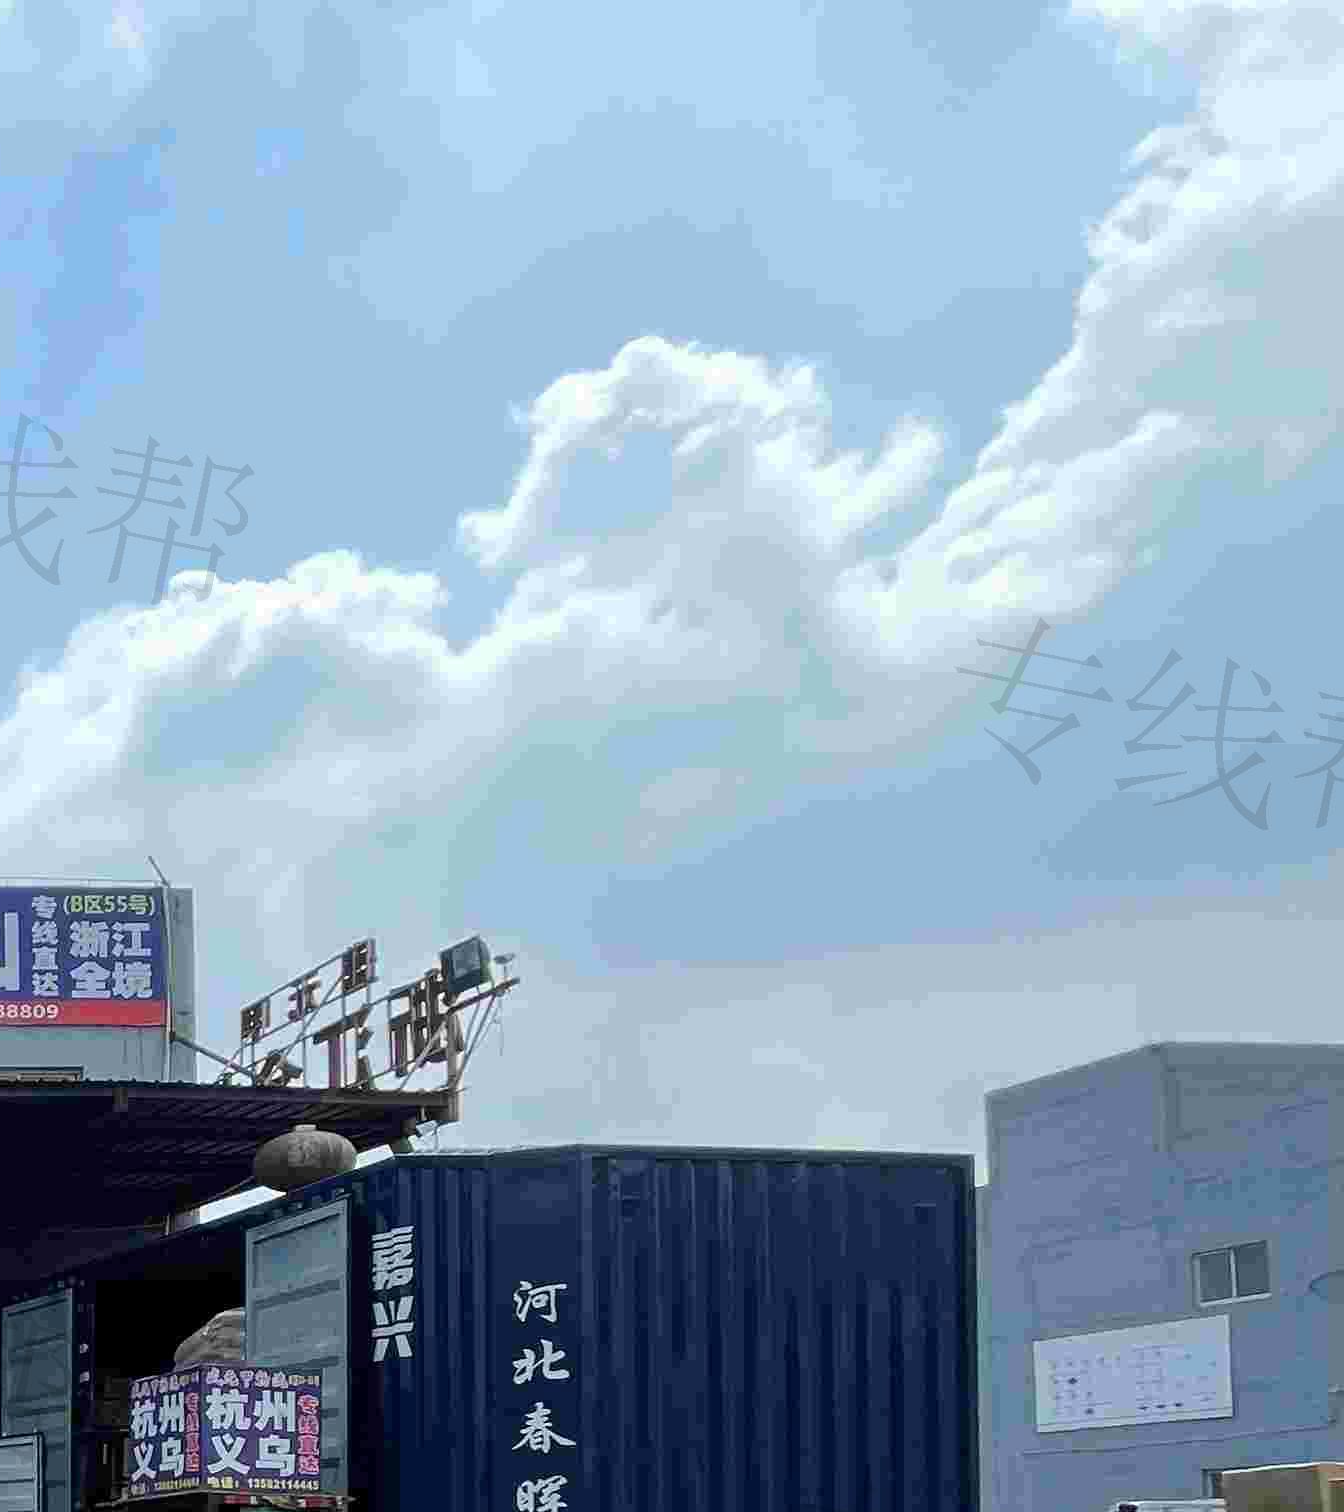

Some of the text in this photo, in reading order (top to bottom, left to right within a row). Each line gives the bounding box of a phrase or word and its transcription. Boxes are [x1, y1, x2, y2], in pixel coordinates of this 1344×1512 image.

[69, 921, 152, 957] 浙江
[70, 961, 152, 999] 全境
[371, 1226, 415, 1362] 嘉兴
[131, 1391, 185, 1439] 杭州
[206, 1388, 296, 1432] 杭州
[131, 1437, 184, 1481] 义乌
[208, 1433, 296, 1476] 义乌
